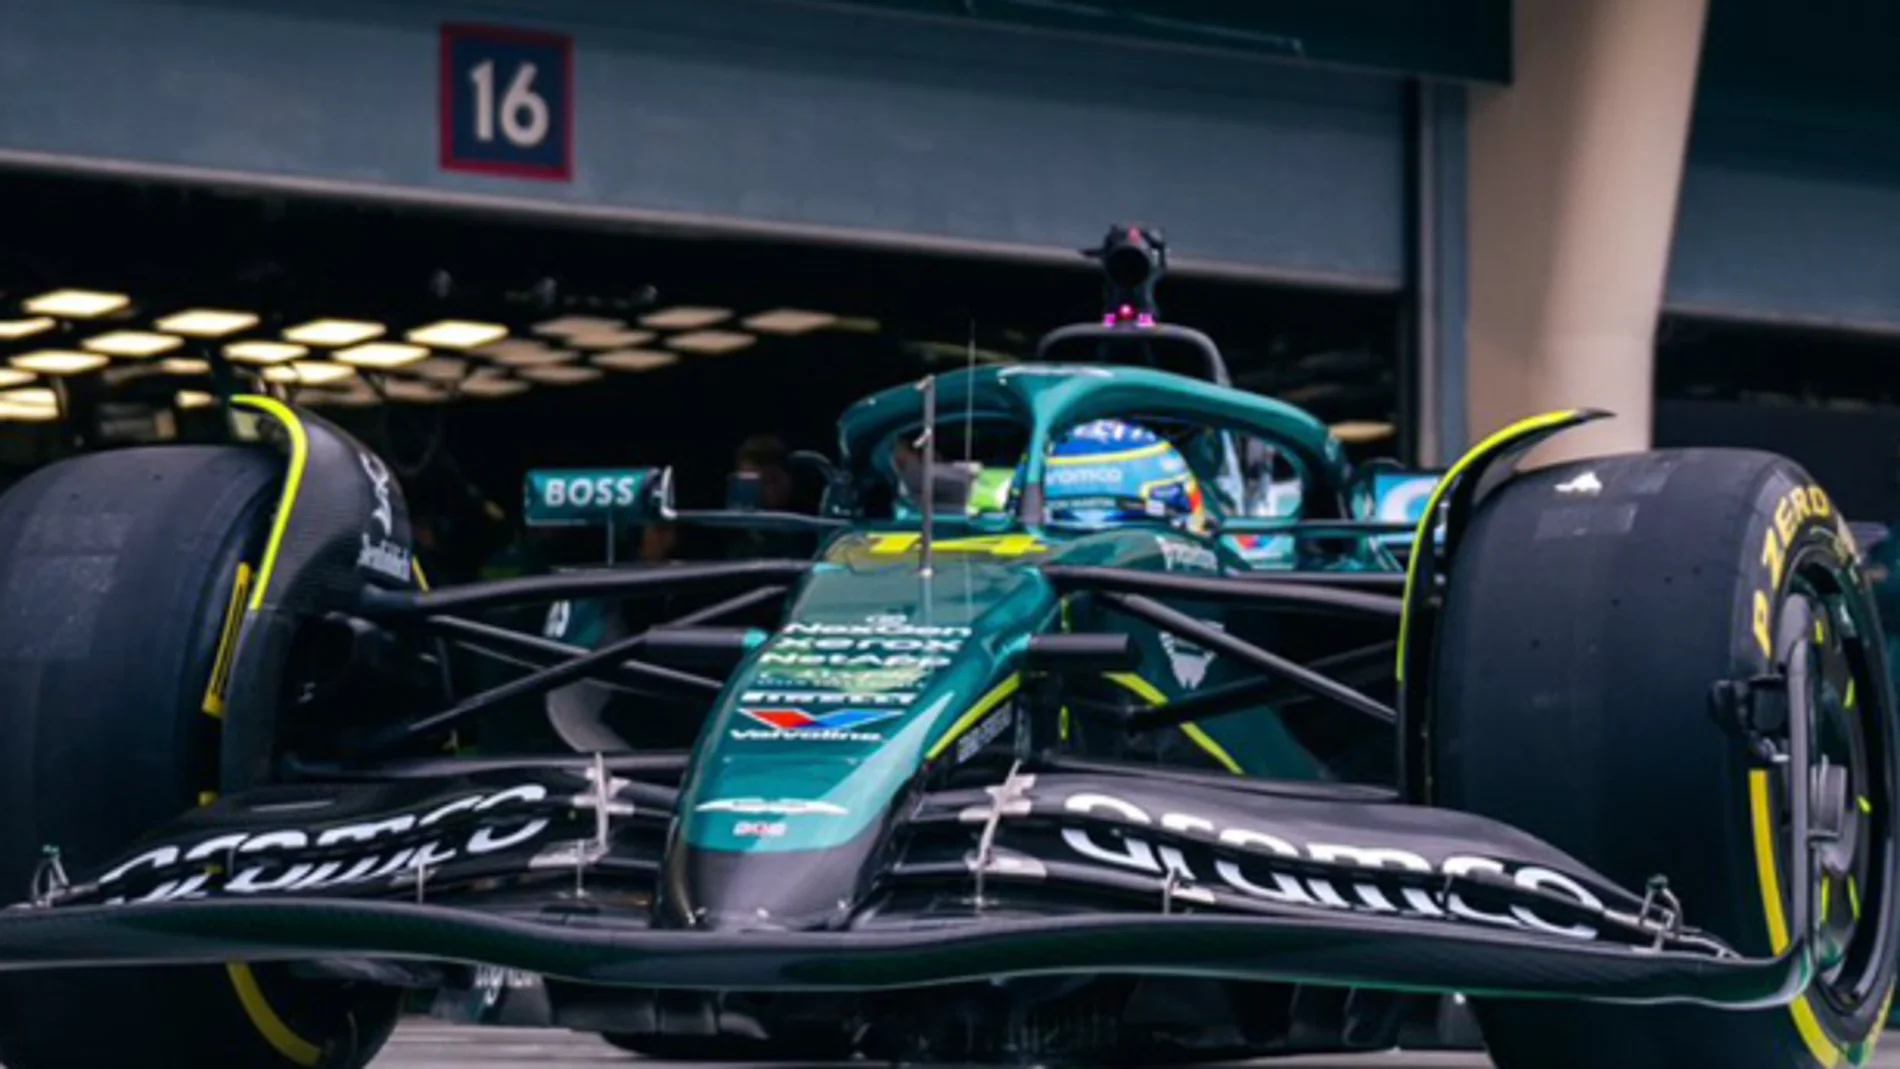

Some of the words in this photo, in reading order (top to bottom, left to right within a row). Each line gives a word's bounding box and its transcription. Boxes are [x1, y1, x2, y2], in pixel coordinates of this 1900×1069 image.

[469, 60, 549, 147] 16
[544, 477, 636, 507] BOSS
[782, 622, 973, 638] NexGen
[759, 653, 950, 669] NetApp
